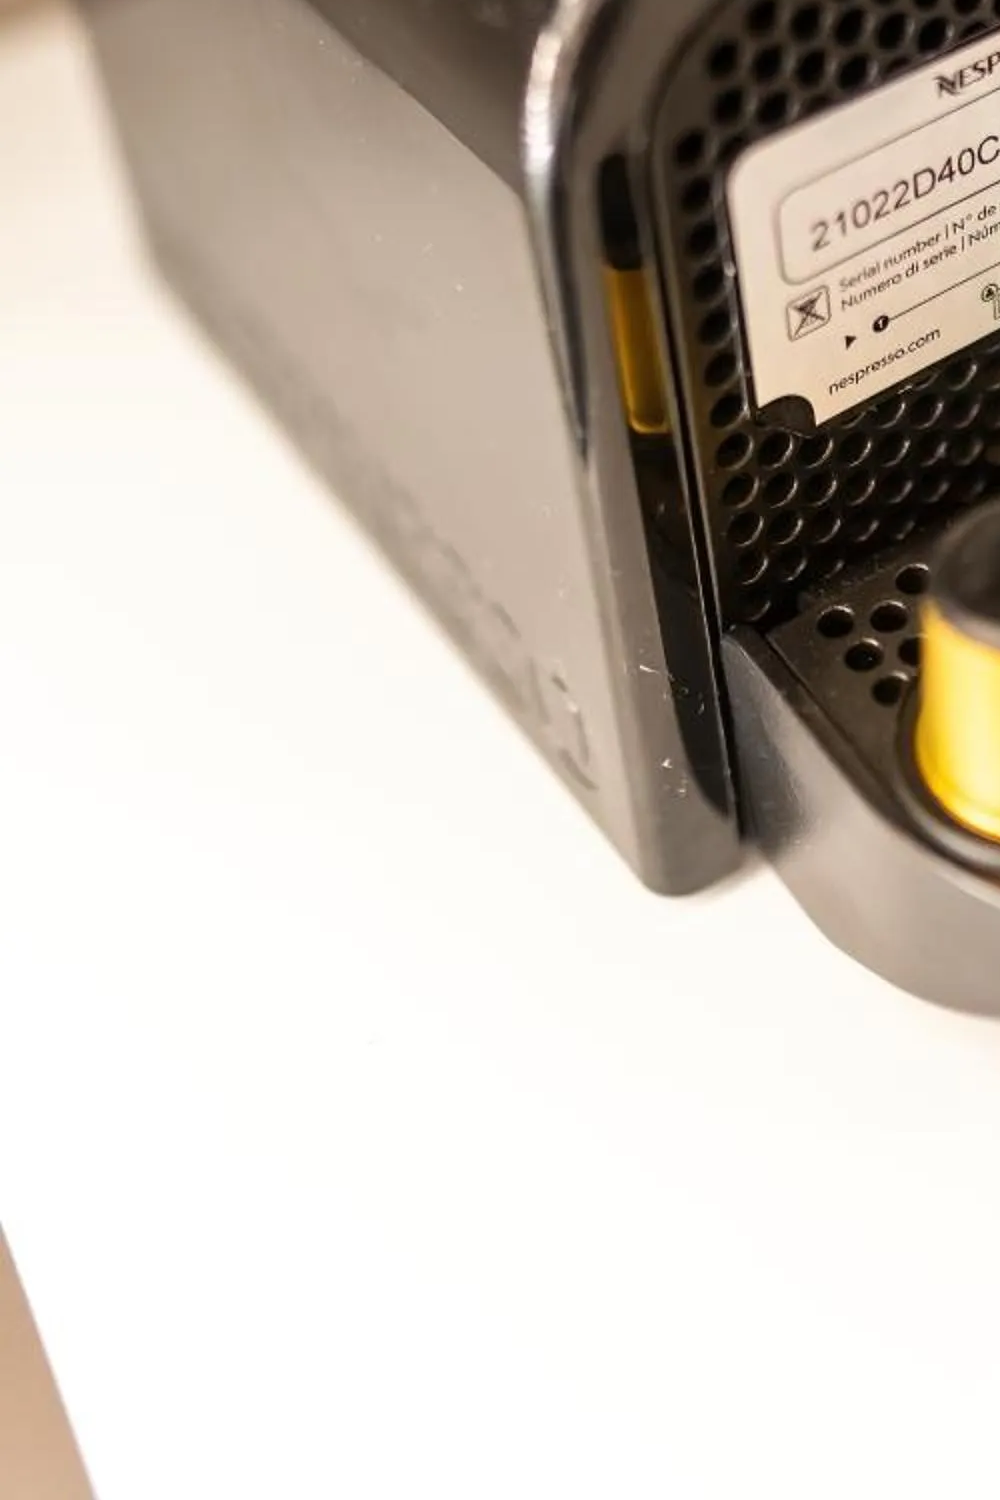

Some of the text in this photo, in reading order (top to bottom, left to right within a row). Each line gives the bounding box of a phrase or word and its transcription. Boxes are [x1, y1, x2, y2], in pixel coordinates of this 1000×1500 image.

[839, 261, 881, 292] Serial
[883, 231, 941, 269] number
[977, 202, 997, 222] de
[841, 275, 902, 311] Numero
[905, 259, 919, 278] di
[922, 243, 957, 267] serie
[828, 328, 942, 396] nespresso.com
